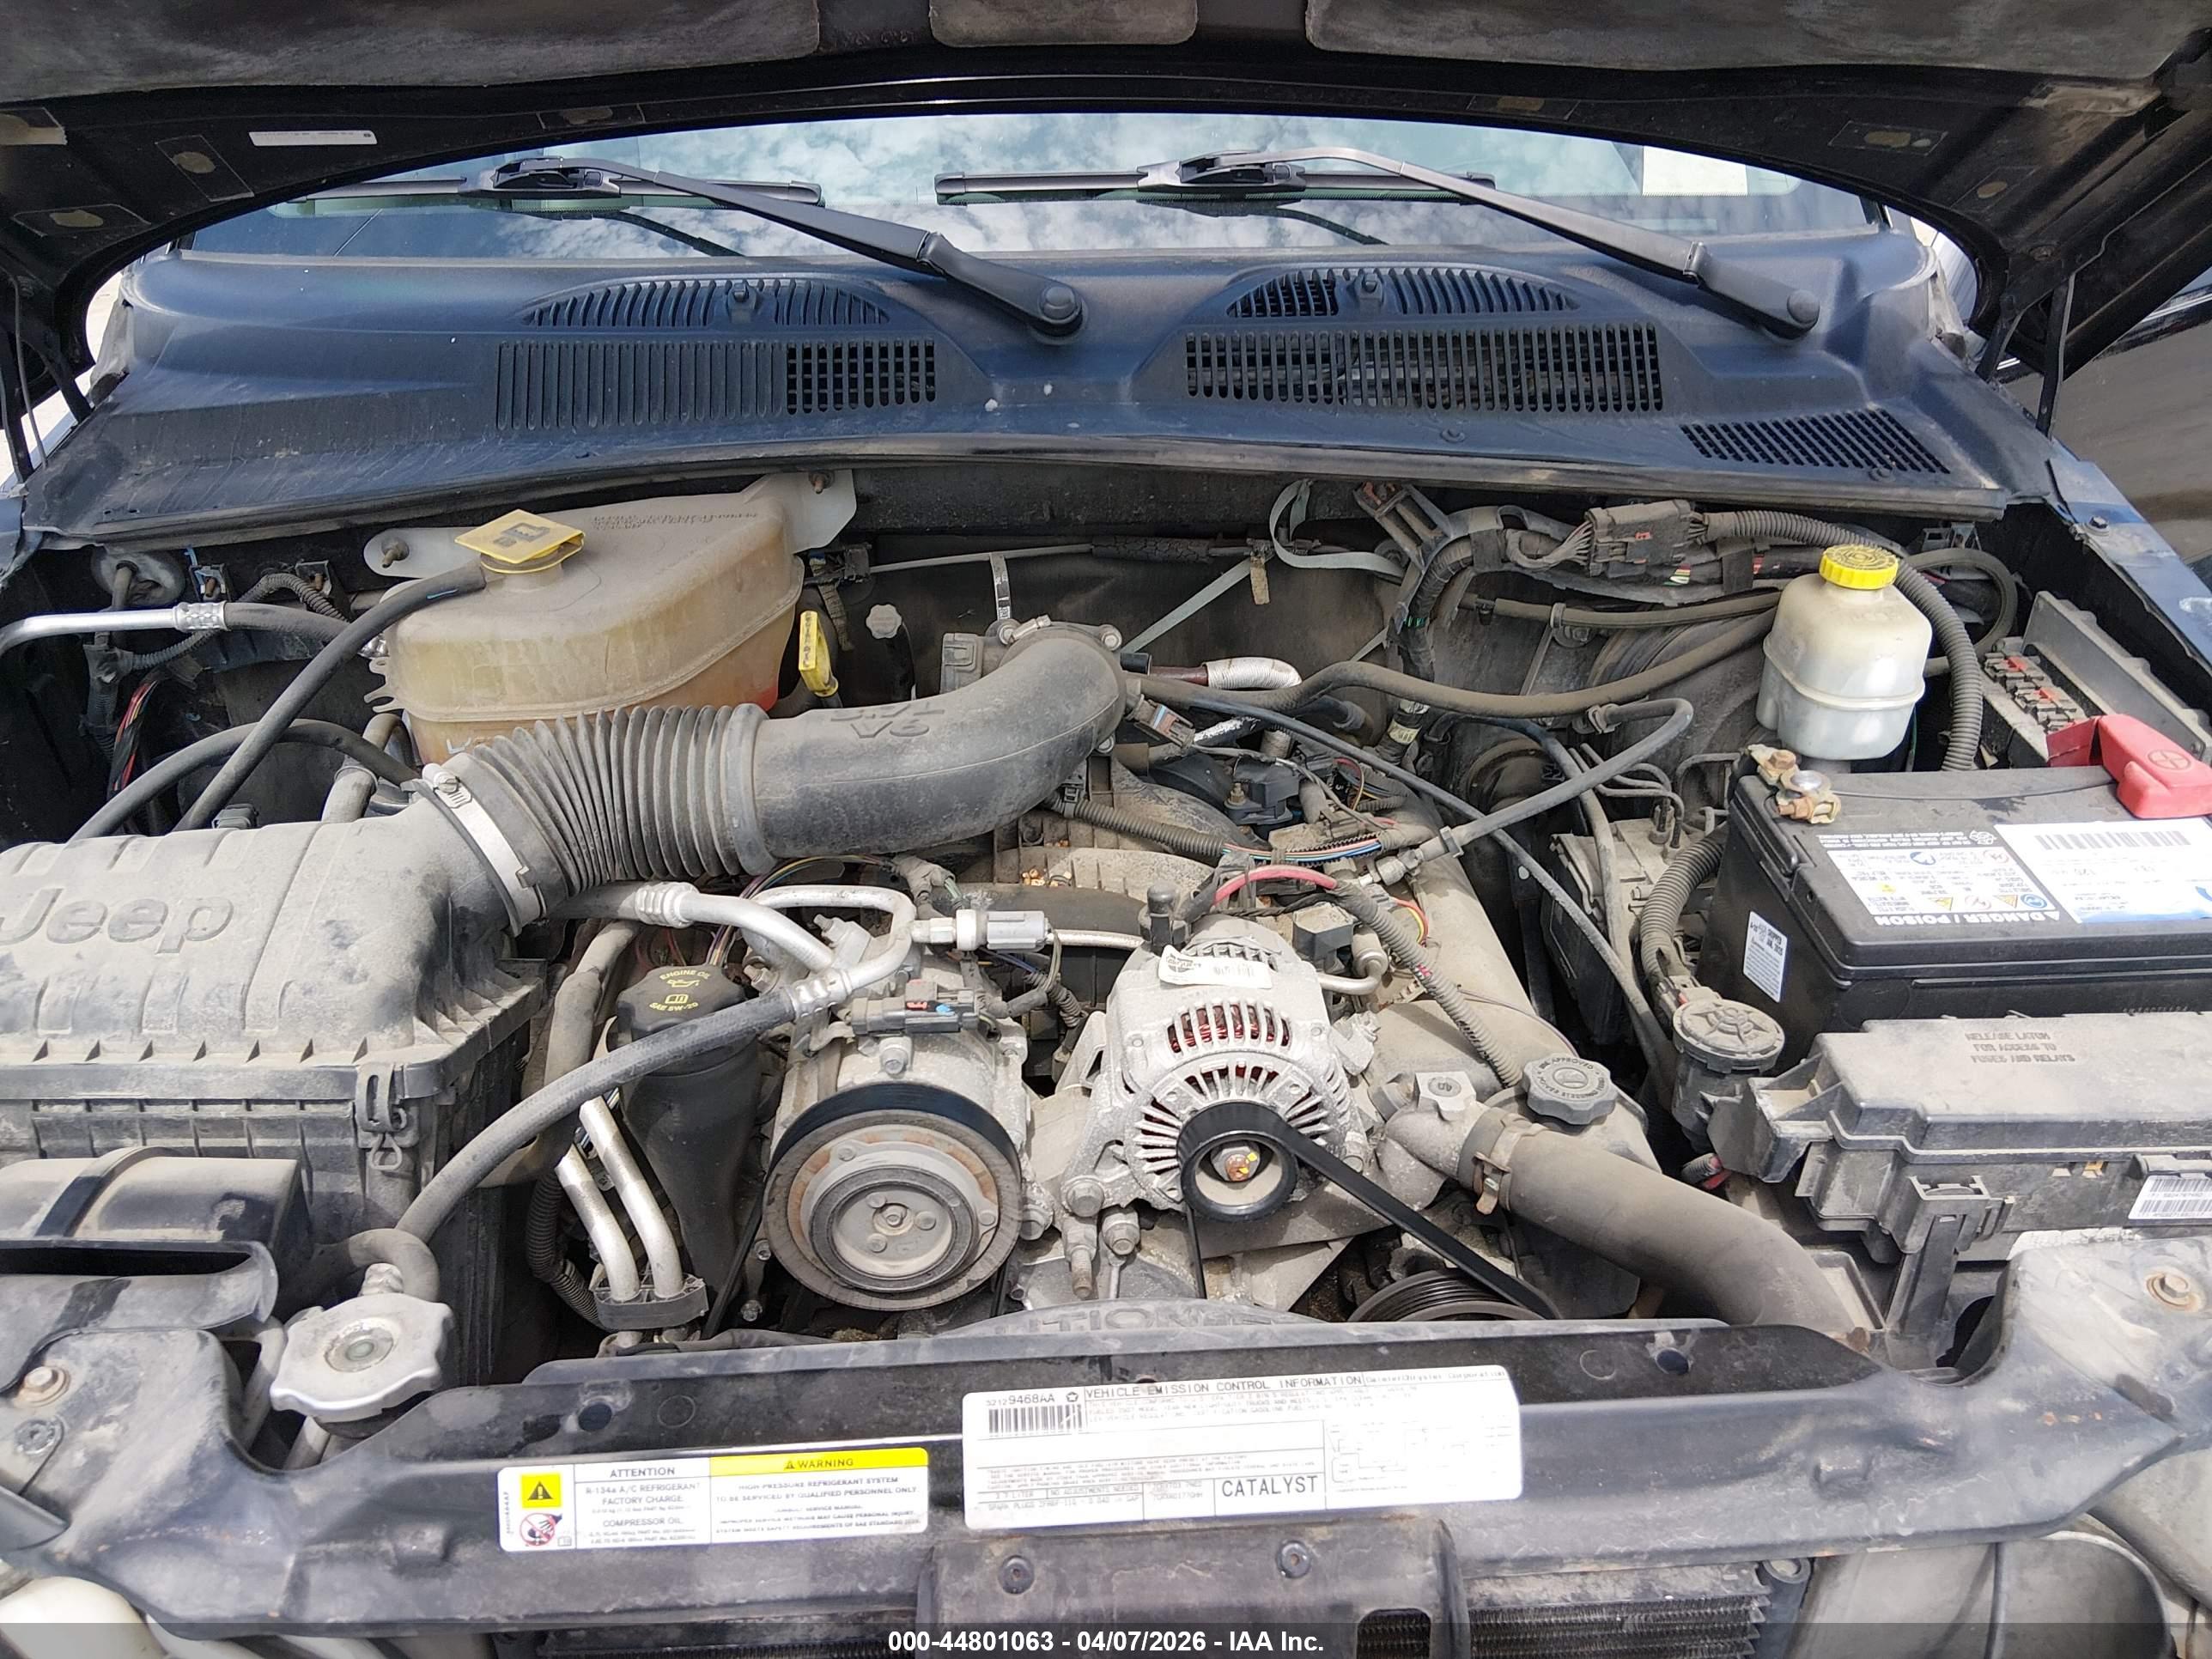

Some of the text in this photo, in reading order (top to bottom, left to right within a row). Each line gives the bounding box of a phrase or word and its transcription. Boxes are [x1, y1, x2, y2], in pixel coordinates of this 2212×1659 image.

[0, 887, 231, 955] Jeep
[1875, 913, 1952, 927] POISON
[1965, 910, 2045, 924] DANGER
[659, 969, 696, 980] ENGINE
[649, 1002, 668, 1012] SAE
[1965, 1032, 2014, 1041] RELEASE
[1972, 1043, 1997, 1052] FOR
[2040, 1042, 2057, 1051] TO
[1551, 1057, 1594, 1070] APPROVED
[1971, 1054, 2075, 1063] FUSES AND RELAYS
[1085, 1386, 1141, 1399] VEHICLE
[1147, 1382, 1210, 1395] EMISSION
[1216, 1378, 1271, 1392] CONTROL
[1279, 1376, 1362, 1389] INFORMATION
[797, 1457, 854, 1468] WARNING
[610, 1467, 676, 1479] ATTENTION
[807, 1478, 864, 1487] REFRIGERANT
[1222, 1475, 1319, 1498] CATALYST
[586, 1482, 701, 1495] R-134a A/C REFRIGERANT
[798, 1490, 842, 1498] QUALIFIED
[844, 1487, 894, 1496] PERSONNEL
[602, 1495, 684, 1505] FACTORY CHARGE
[603, 1517, 665, 1528] COMPRESSOR
